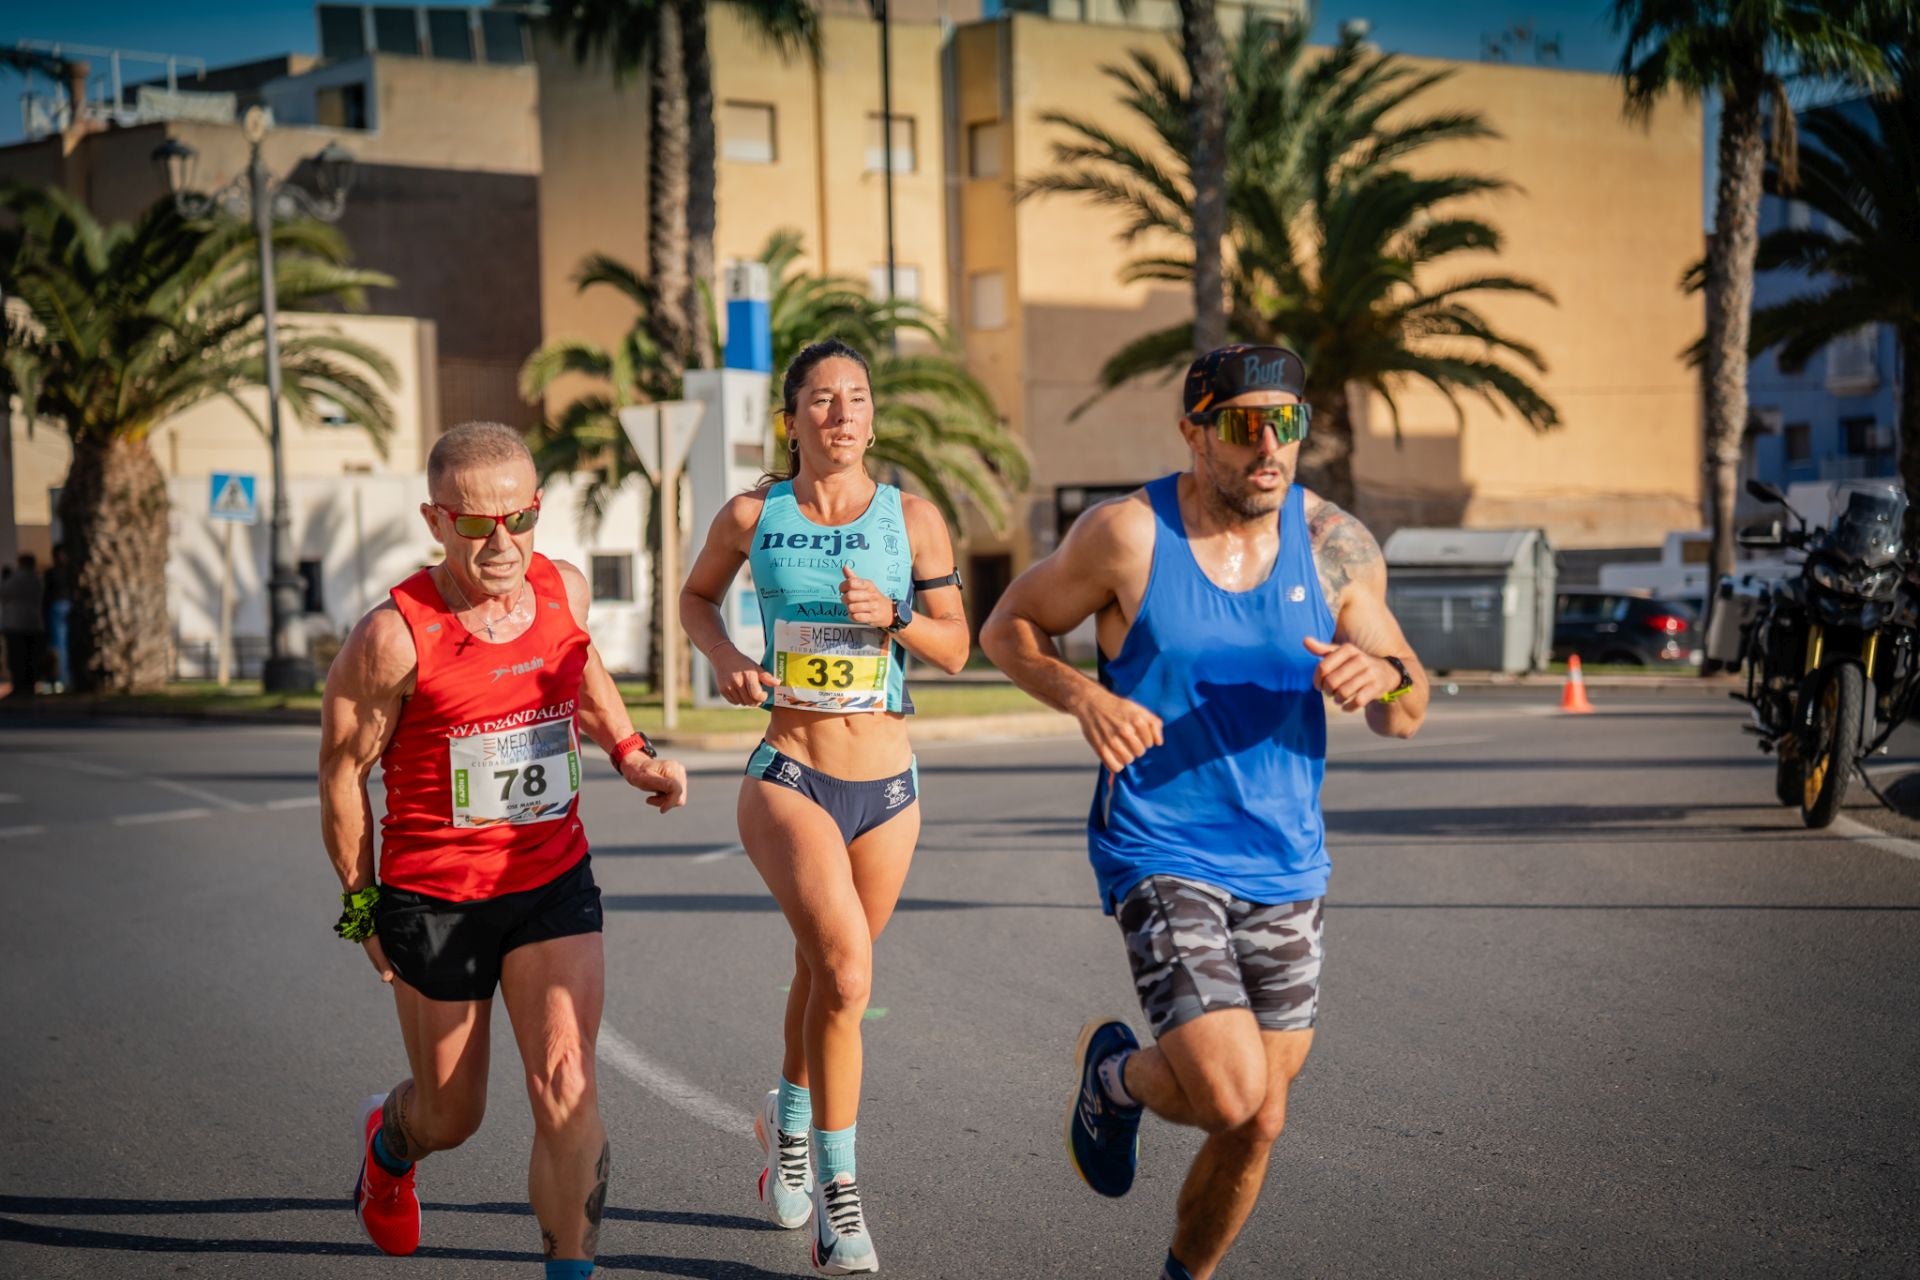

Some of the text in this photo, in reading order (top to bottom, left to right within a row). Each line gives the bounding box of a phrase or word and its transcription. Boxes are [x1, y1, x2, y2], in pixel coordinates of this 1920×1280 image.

[1243, 353, 1286, 386] Buff
[760, 529, 870, 556] nerja
[769, 557, 856, 570] ATLETISMO
[812, 627, 854, 642] MEDIA
[806, 658, 854, 689] 33
[497, 729, 541, 751] MEDIA
[493, 764, 547, 802] 78
